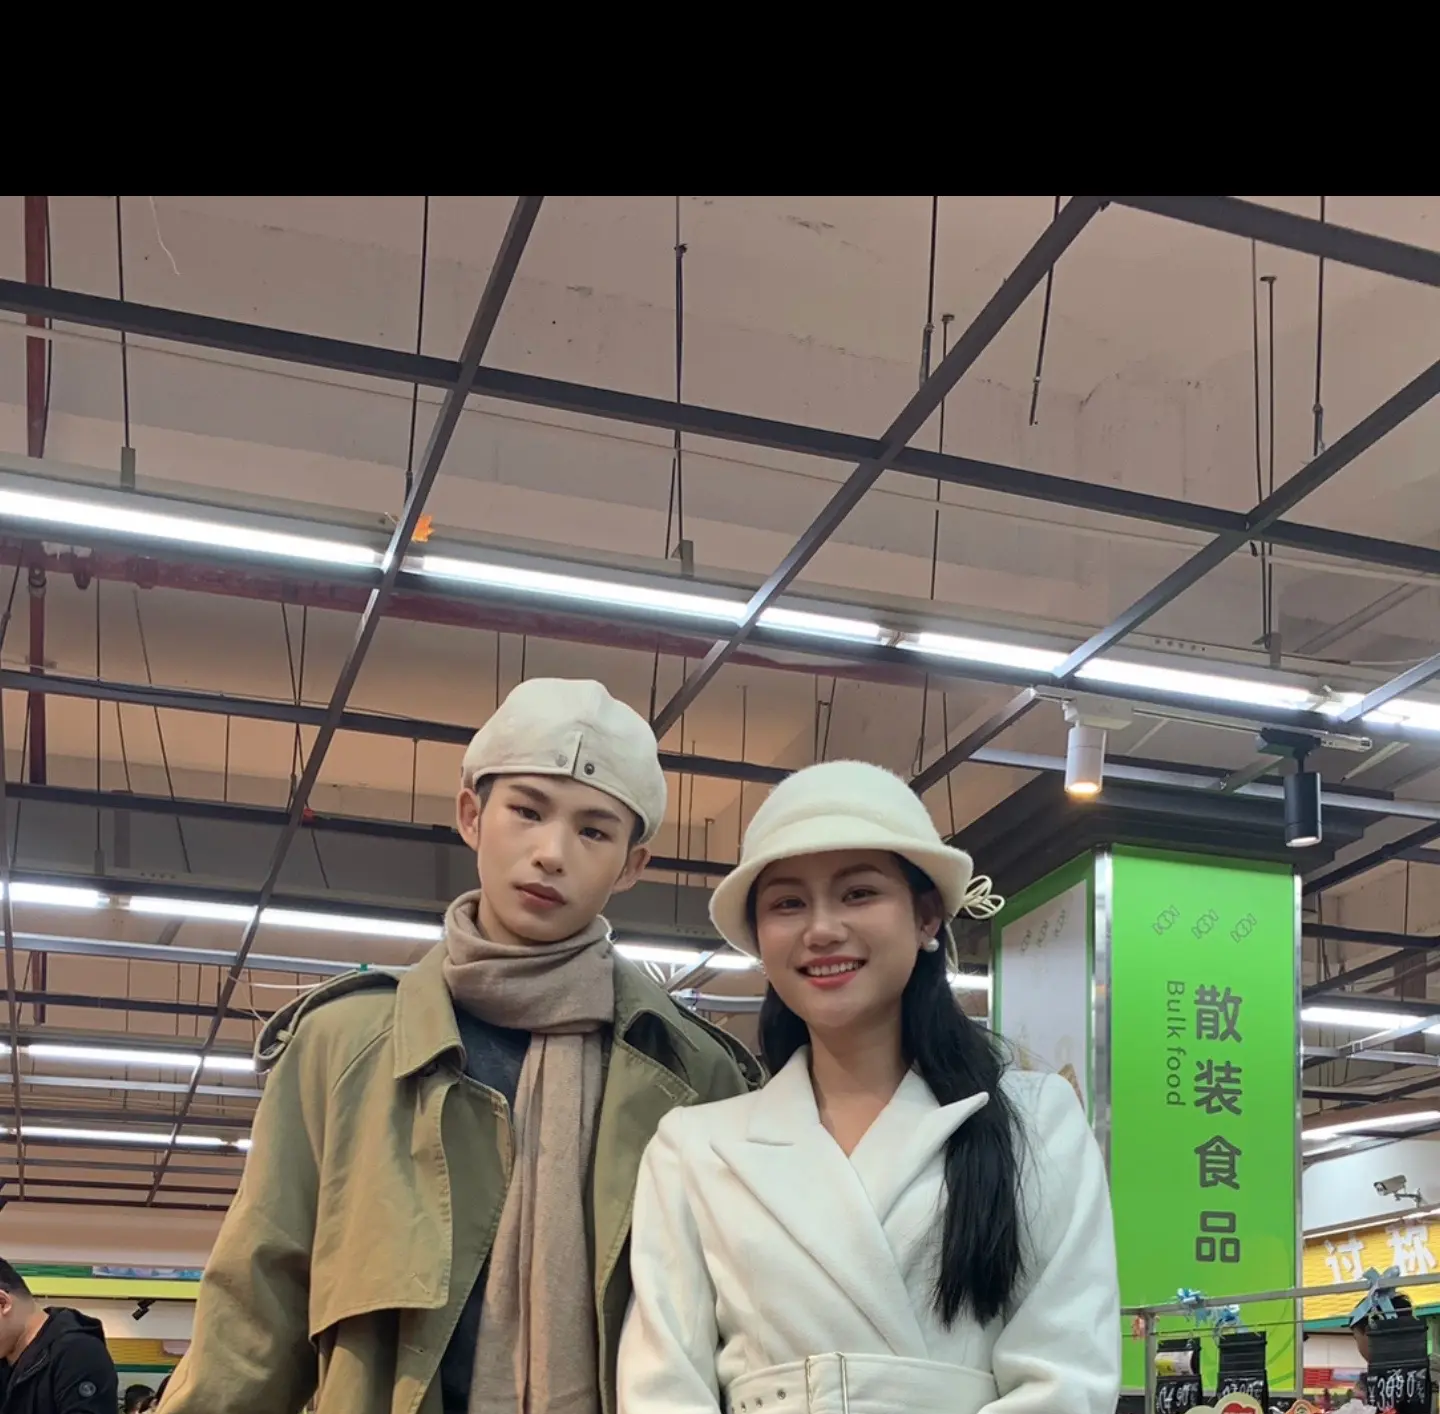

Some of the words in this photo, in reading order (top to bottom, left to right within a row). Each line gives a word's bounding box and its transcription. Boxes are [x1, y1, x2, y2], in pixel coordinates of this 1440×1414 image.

[1167, 980, 1186, 1039] Bulk
[1166, 1045, 1186, 1106] food
[1194, 984, 1243, 1263] 散装食品
